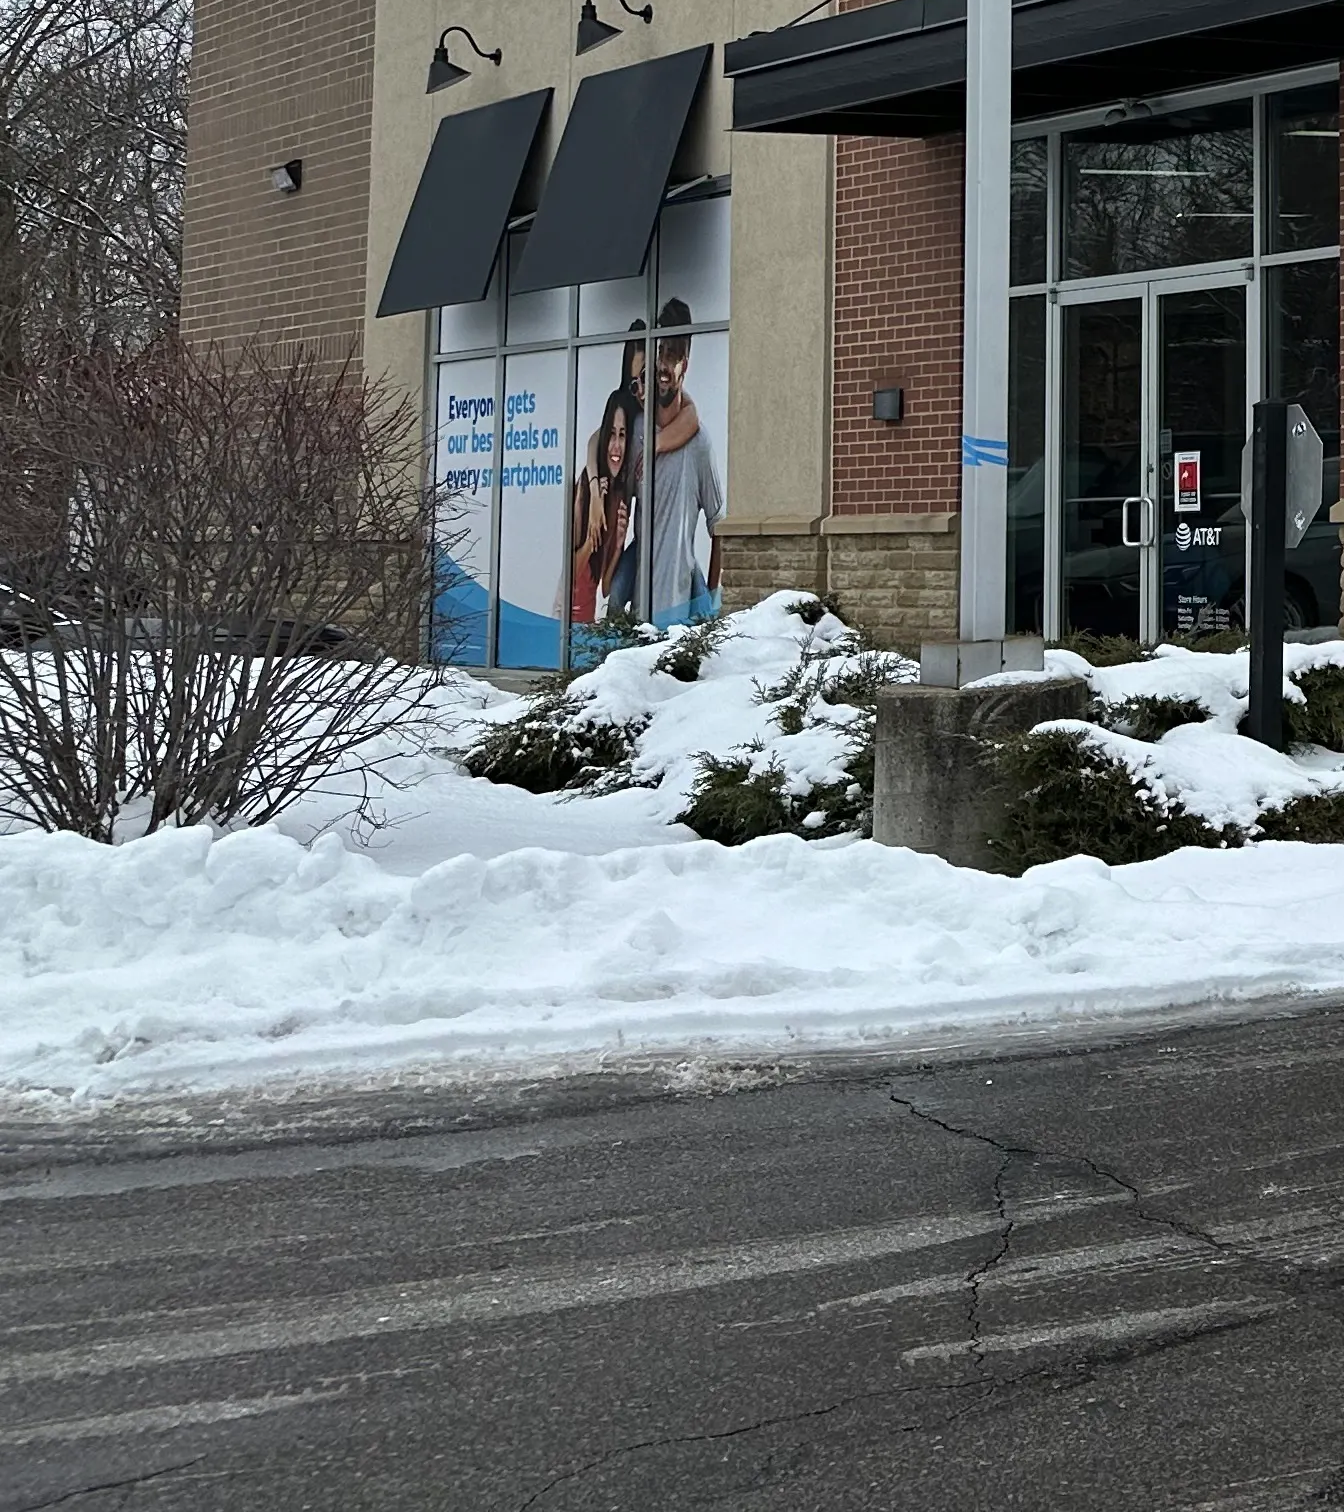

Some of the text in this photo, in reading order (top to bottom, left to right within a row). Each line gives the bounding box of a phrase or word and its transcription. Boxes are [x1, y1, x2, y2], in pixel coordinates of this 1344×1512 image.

[449, 389, 536, 425] Everyon gets
[448, 422, 558, 454] our bes deals on
[446, 468, 480, 495] every
[1193, 527, 1222, 546] AT&T
